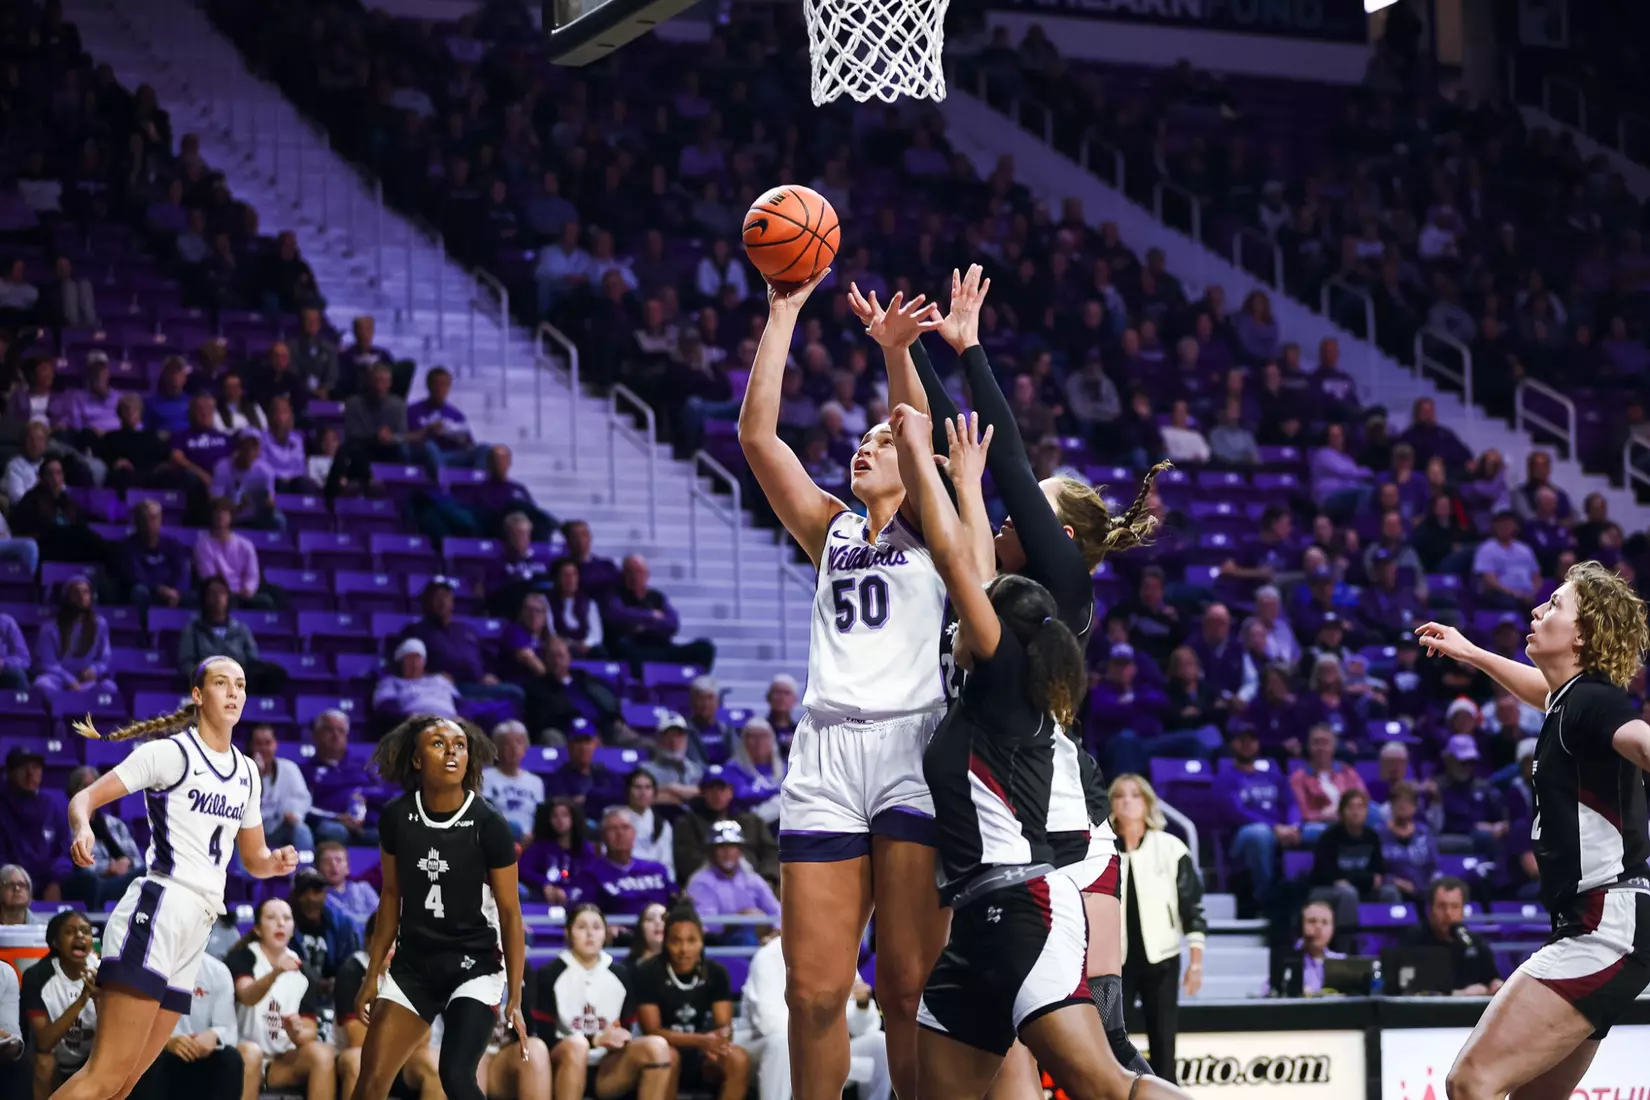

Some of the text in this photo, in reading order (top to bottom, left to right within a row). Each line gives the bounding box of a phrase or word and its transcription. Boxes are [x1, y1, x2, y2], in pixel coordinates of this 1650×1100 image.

[832, 575, 890, 633] 50
[188, 789, 245, 821] Wildcat
[209, 825, 223, 866] 4
[424, 884, 445, 918] 4
